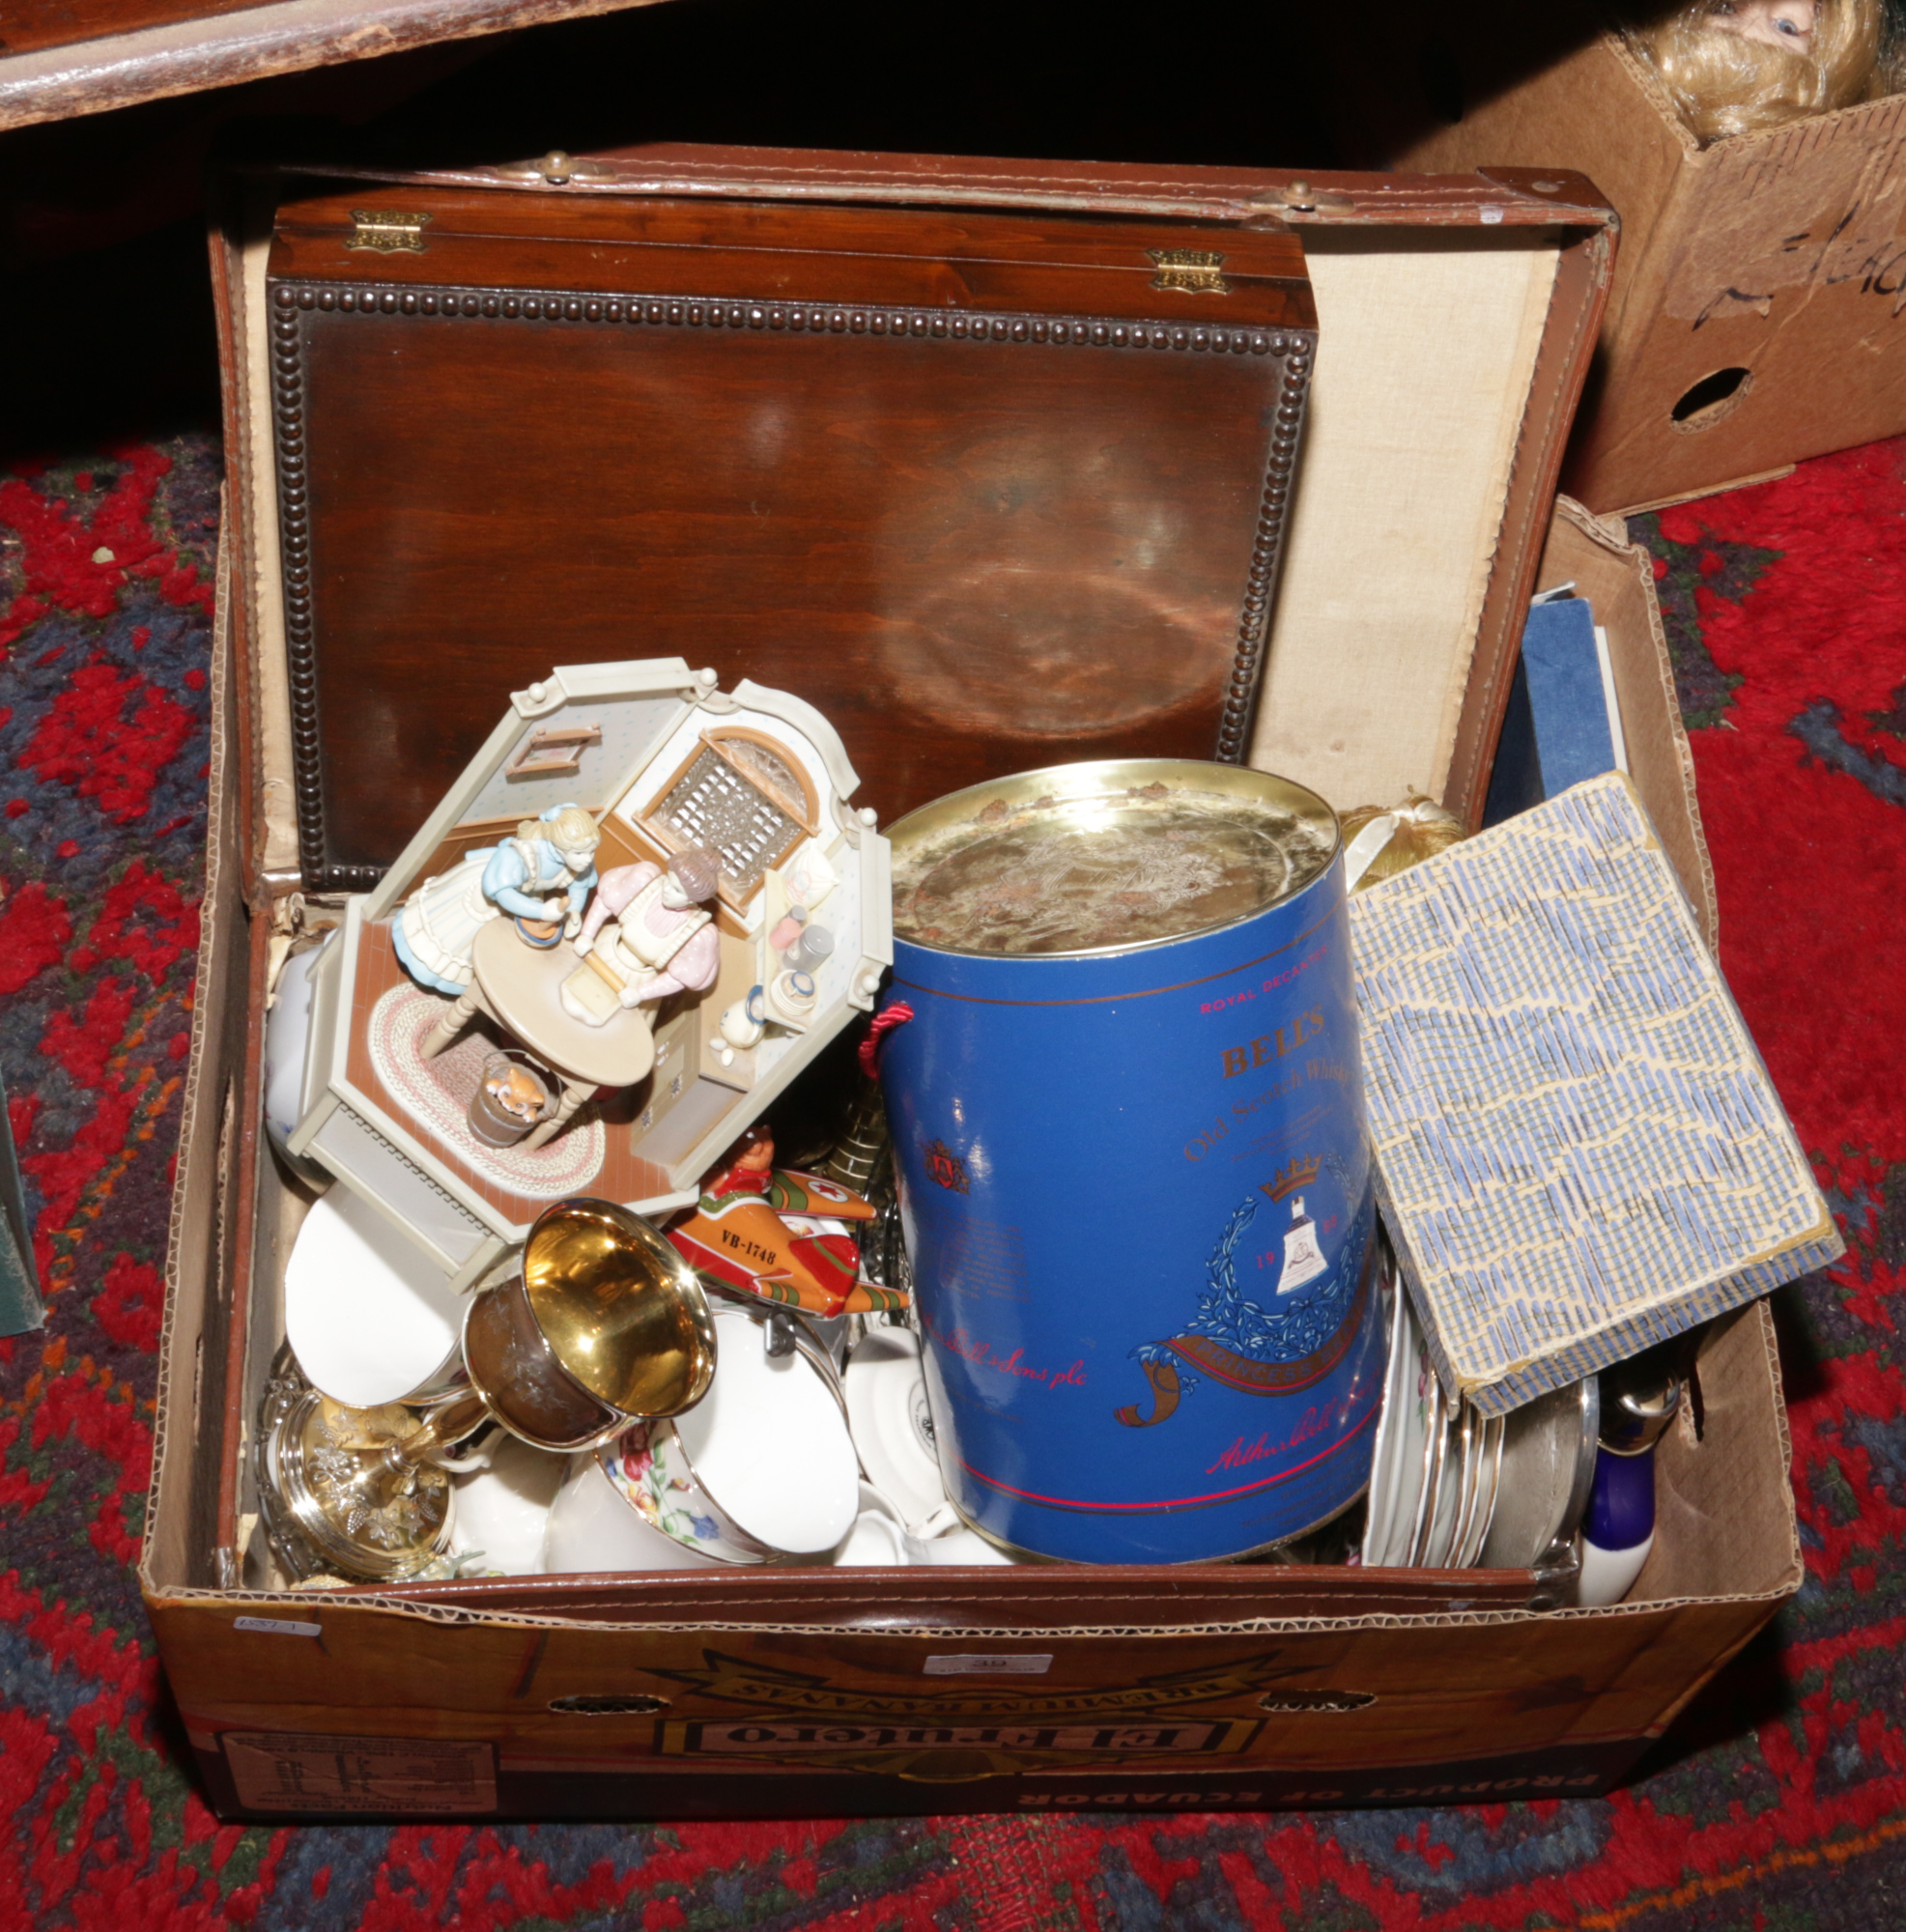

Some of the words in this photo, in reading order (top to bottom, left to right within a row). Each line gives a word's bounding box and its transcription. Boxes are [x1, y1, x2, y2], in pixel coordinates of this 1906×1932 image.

[1199, 989, 1257, 1015] ROYAL
[1262, 944, 1328, 993] DECANTER
[1219, 1004, 1325, 1080] BELL'S
[1183, 1118, 1230, 1162] Old
[1232, 1074, 1304, 1122] Scotch
[724, 1230, 776, 1264] VB-1748
[1256, 1251, 1275, 1270] 19
[945, 1328, 991, 1365] Bell
[998, 1347, 1049, 1381] Sons
[1048, 1359, 1089, 1390] plc
[1195, 1339, 1313, 1384] PRINCESS
[1206, 1432, 1291, 1474] Arthur
[727, 1682, 963, 1712] BANANAS
[973, 1681, 1226, 1715] PREMIUM
[724, 1724, 1060, 1749] Frutero
[1079, 1725, 1184, 1750] El
[1015, 1790, 1263, 1806] ECUADOR
[1278, 1789, 1345, 1803] OF
[1363, 1773, 1600, 1799] PRODUCT
